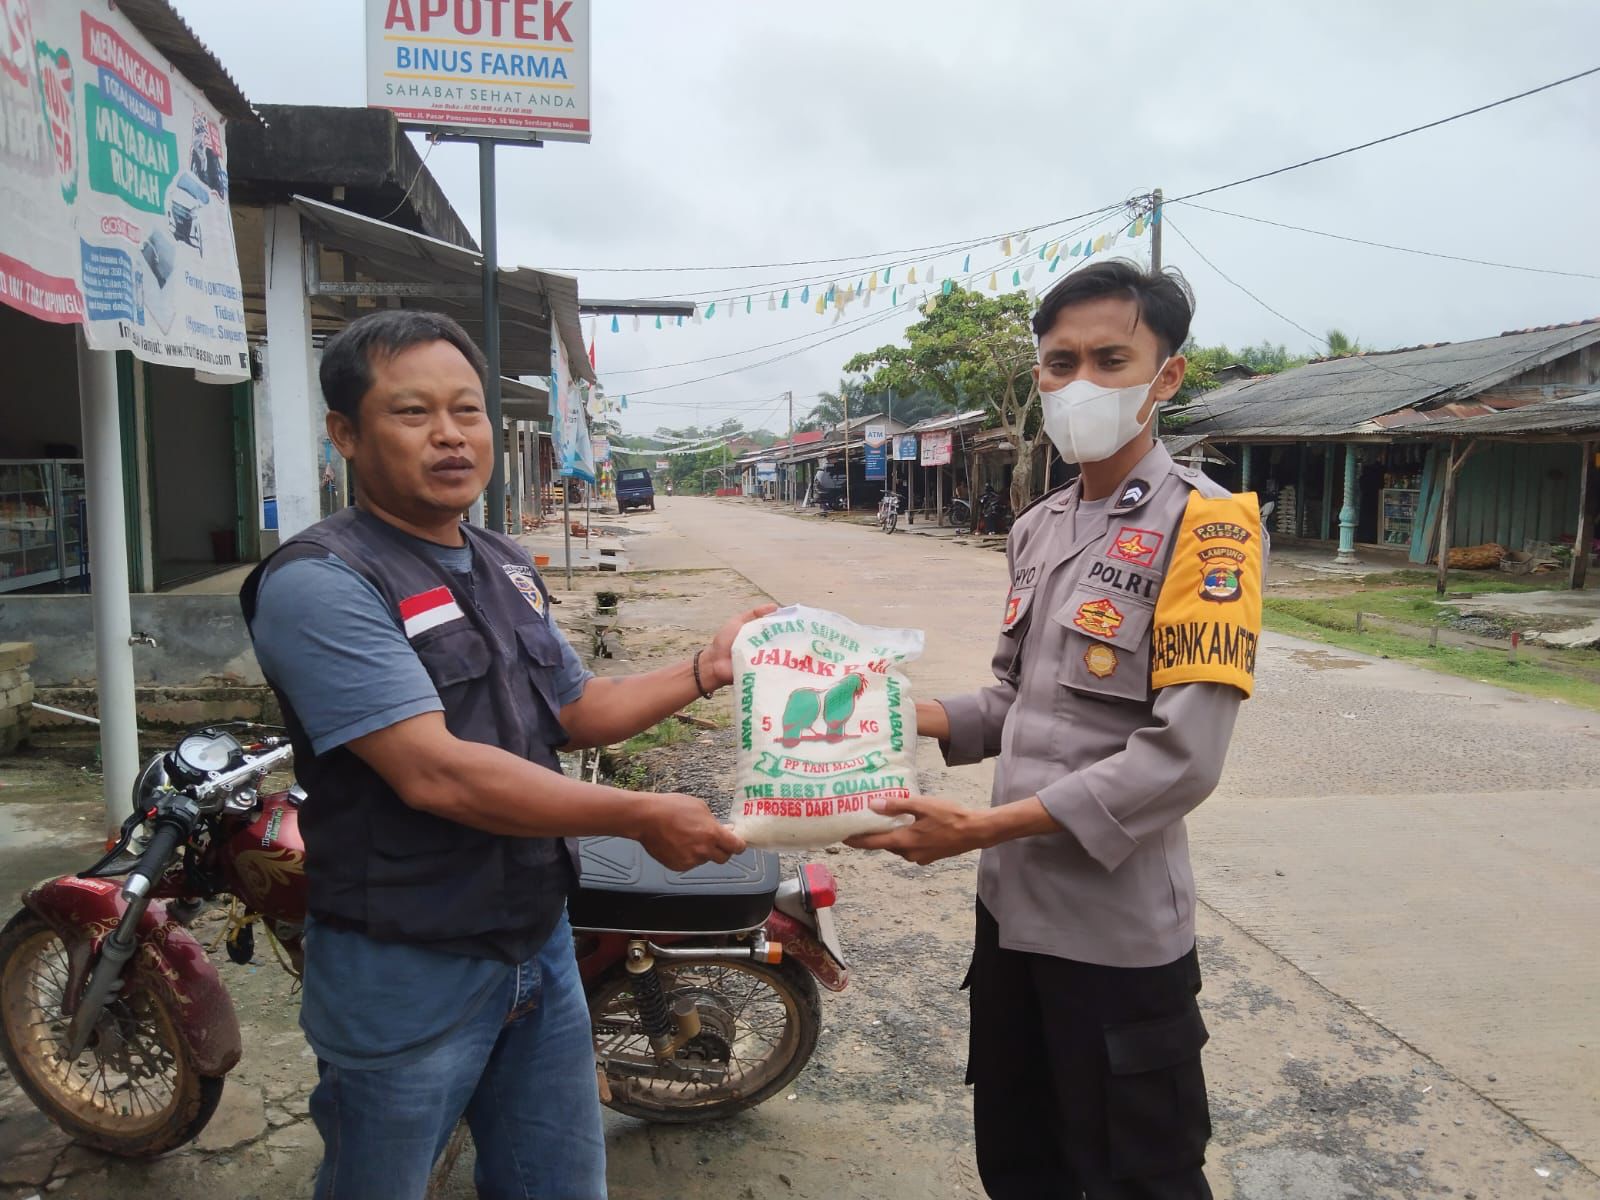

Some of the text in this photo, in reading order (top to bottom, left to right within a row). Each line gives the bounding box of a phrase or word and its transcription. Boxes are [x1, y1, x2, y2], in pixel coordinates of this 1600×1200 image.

[384, 0, 574, 42] APOTEK
[90, 27, 164, 104] MENANGKAN
[396, 46, 568, 79] BINUS FARMA
[386, 83, 575, 108] SAHABAT SEHAT ANDA
[1197, 524, 1246, 537] POLRES
[1201, 548, 1243, 560] LAMPUNG
[1088, 561, 1154, 598] POLRI
[747, 619, 860, 653] BERAS SUPER
[750, 648, 836, 677] JALAK
[811, 639, 846, 663] Cap
[762, 716, 879, 733] 5 KG
[784, 756, 865, 773] PP TANI MAJU
[743, 776, 904, 799] THE BEST QUALITY
[743, 802, 753, 816] DI
[756, 800, 802, 817] PROSES
[805, 799, 833, 817] DARI
[837, 796, 864, 814] PADI
